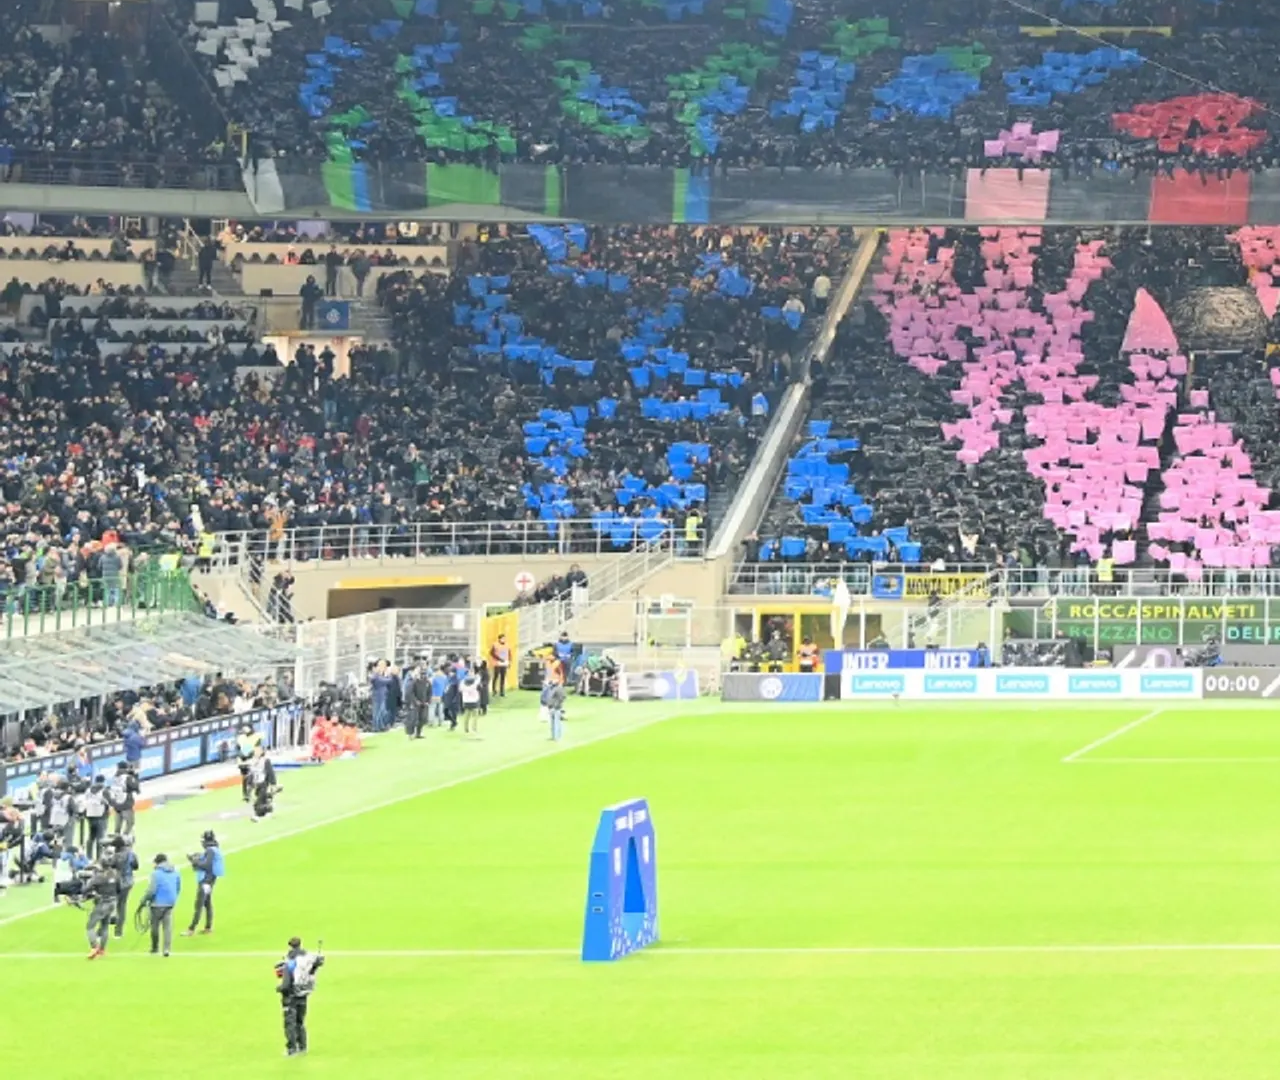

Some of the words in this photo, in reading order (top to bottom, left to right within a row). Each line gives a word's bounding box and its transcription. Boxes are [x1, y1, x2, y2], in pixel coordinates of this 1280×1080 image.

[1069, 604, 1256, 619] ROCCASPINALVETI
[1068, 625, 1173, 640] ROZZANO
[842, 652, 889, 669] INTER
[924, 652, 971, 669] INTER
[855, 679, 900, 689] Lenovo
[928, 679, 973, 689] Lenovo
[1001, 679, 1045, 689] Lenovo
[1073, 679, 1117, 689] Lenovo
[1143, 679, 1190, 689] Lenovo
[1205, 675, 1260, 692] 00:00
